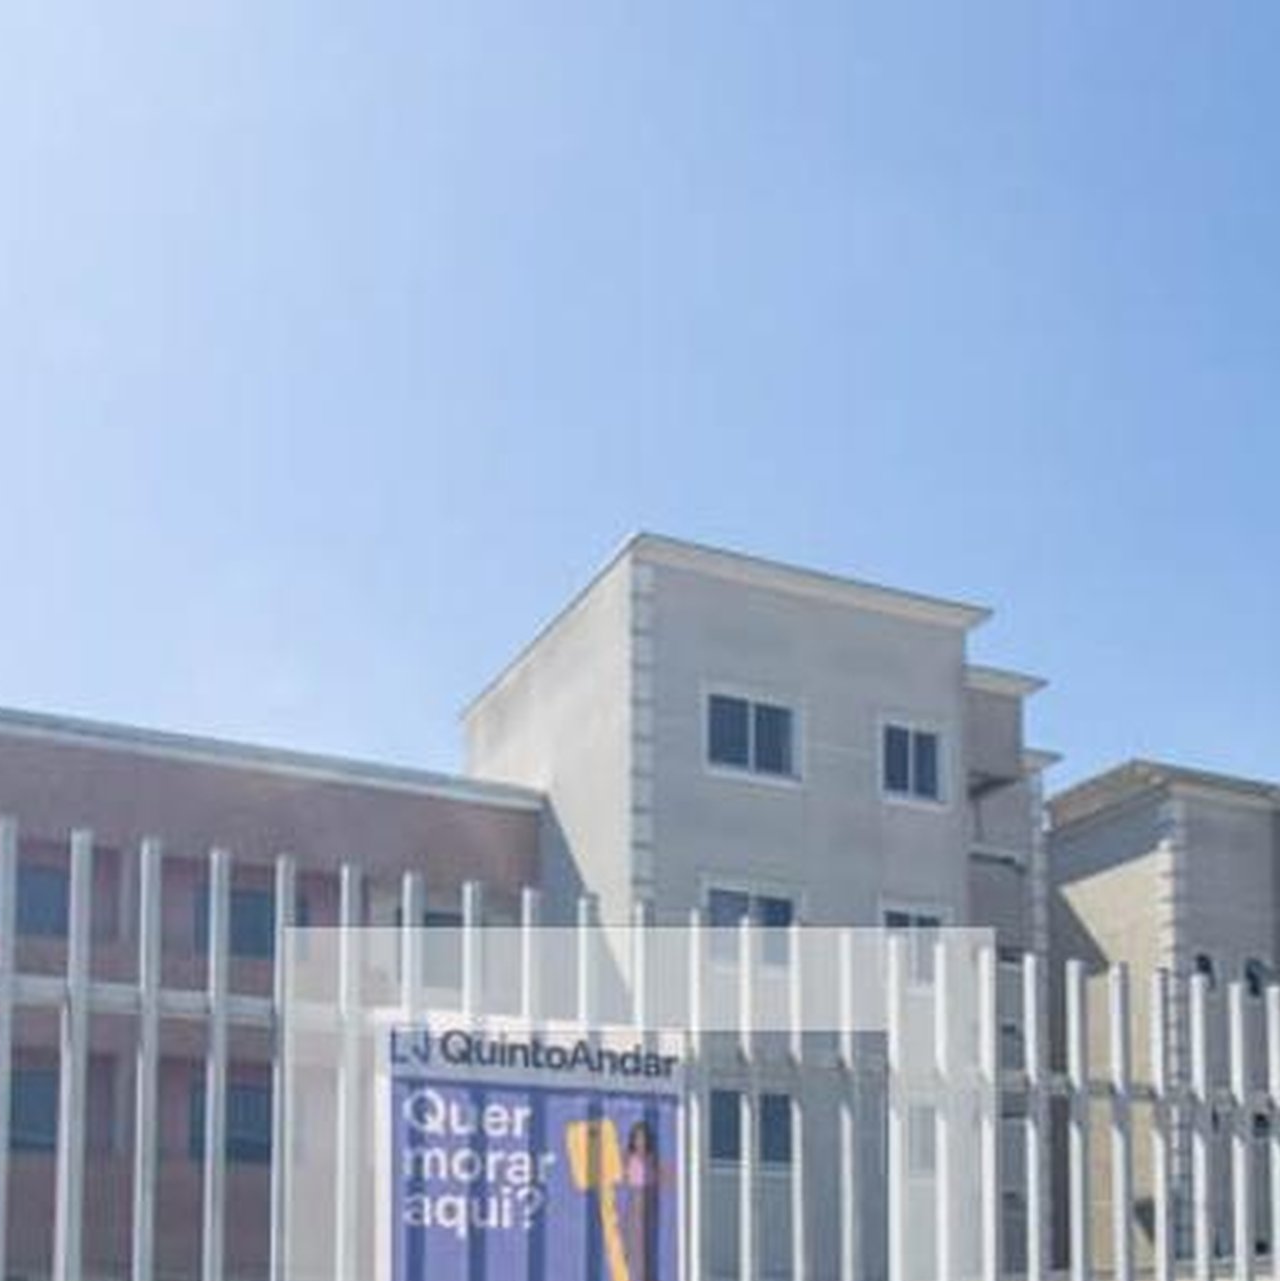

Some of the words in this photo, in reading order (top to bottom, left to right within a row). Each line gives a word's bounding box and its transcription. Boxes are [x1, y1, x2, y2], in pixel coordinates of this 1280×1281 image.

[439, 1028, 678, 1076] QuintoAndar
[403, 1089, 531, 1137] Quer
[404, 1149, 555, 1184] morar
[404, 1187, 542, 1238] aqui?
